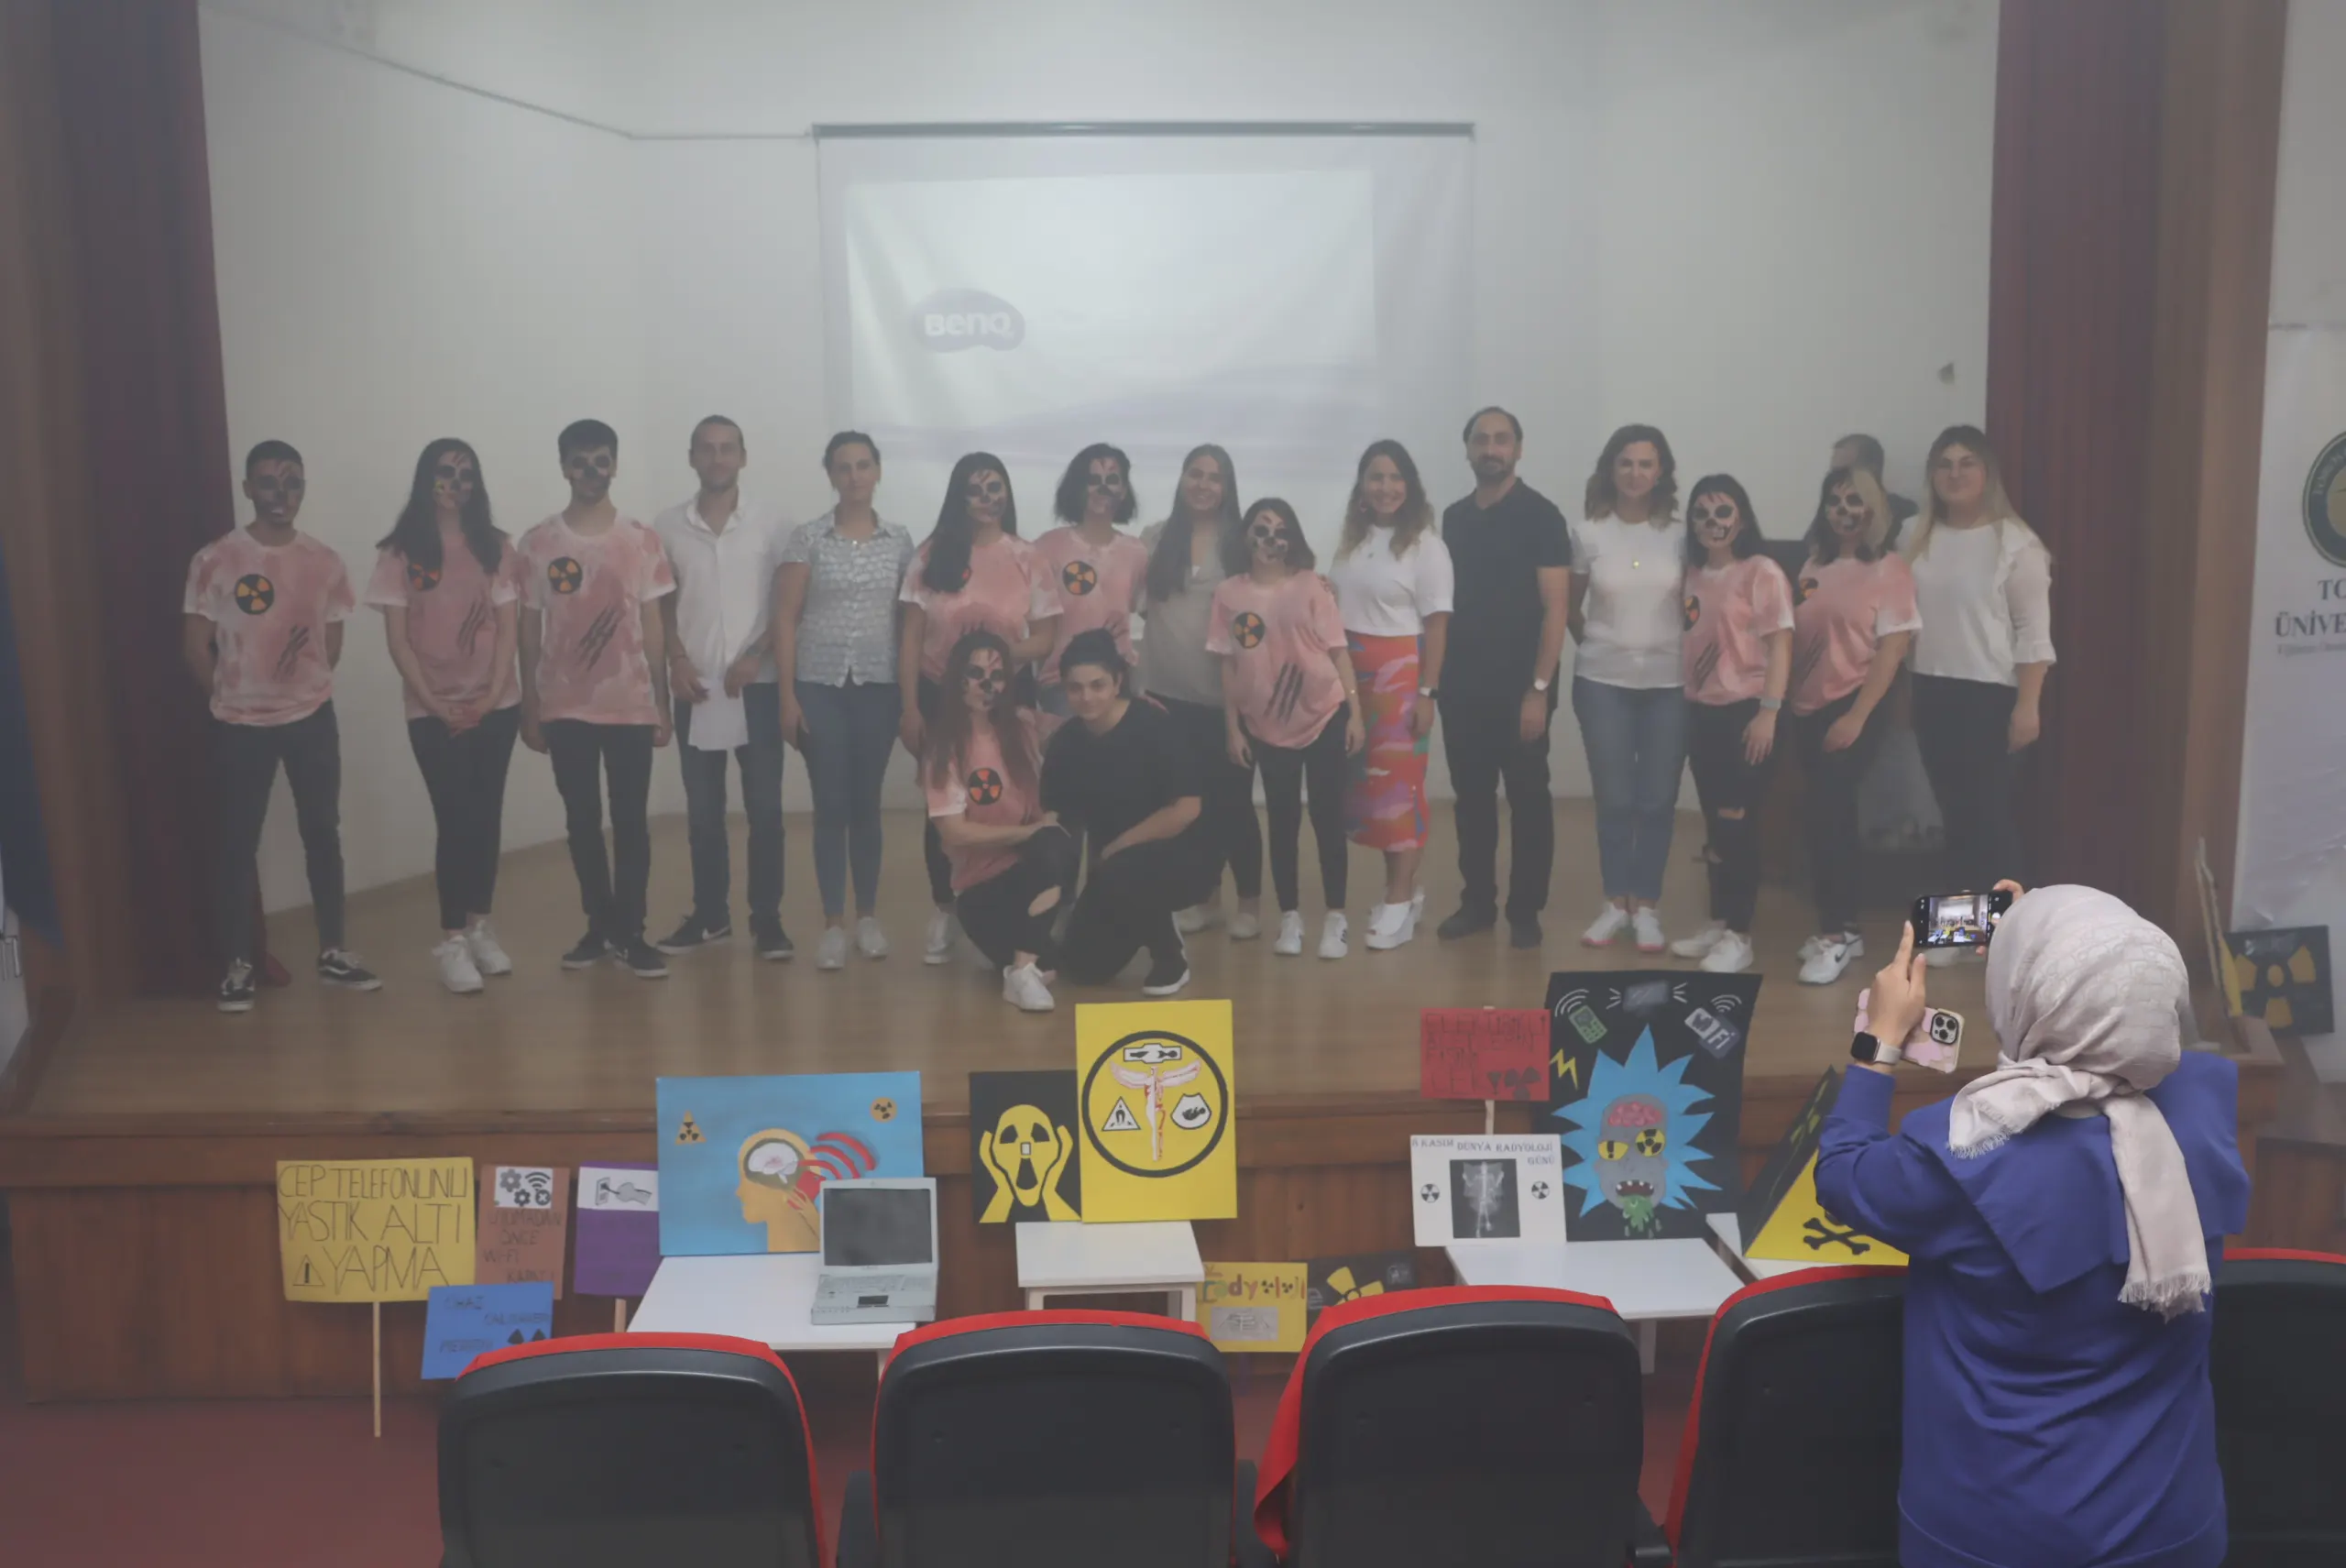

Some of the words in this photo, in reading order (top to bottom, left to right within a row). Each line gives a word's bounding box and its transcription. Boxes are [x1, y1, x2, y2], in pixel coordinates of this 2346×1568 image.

[1420, 1137, 1454, 1148] KASIM
[278, 1164, 326, 1198] CEP
[379, 1203, 461, 1245] ALTI
[322, 1245, 451, 1296] YAPMA
